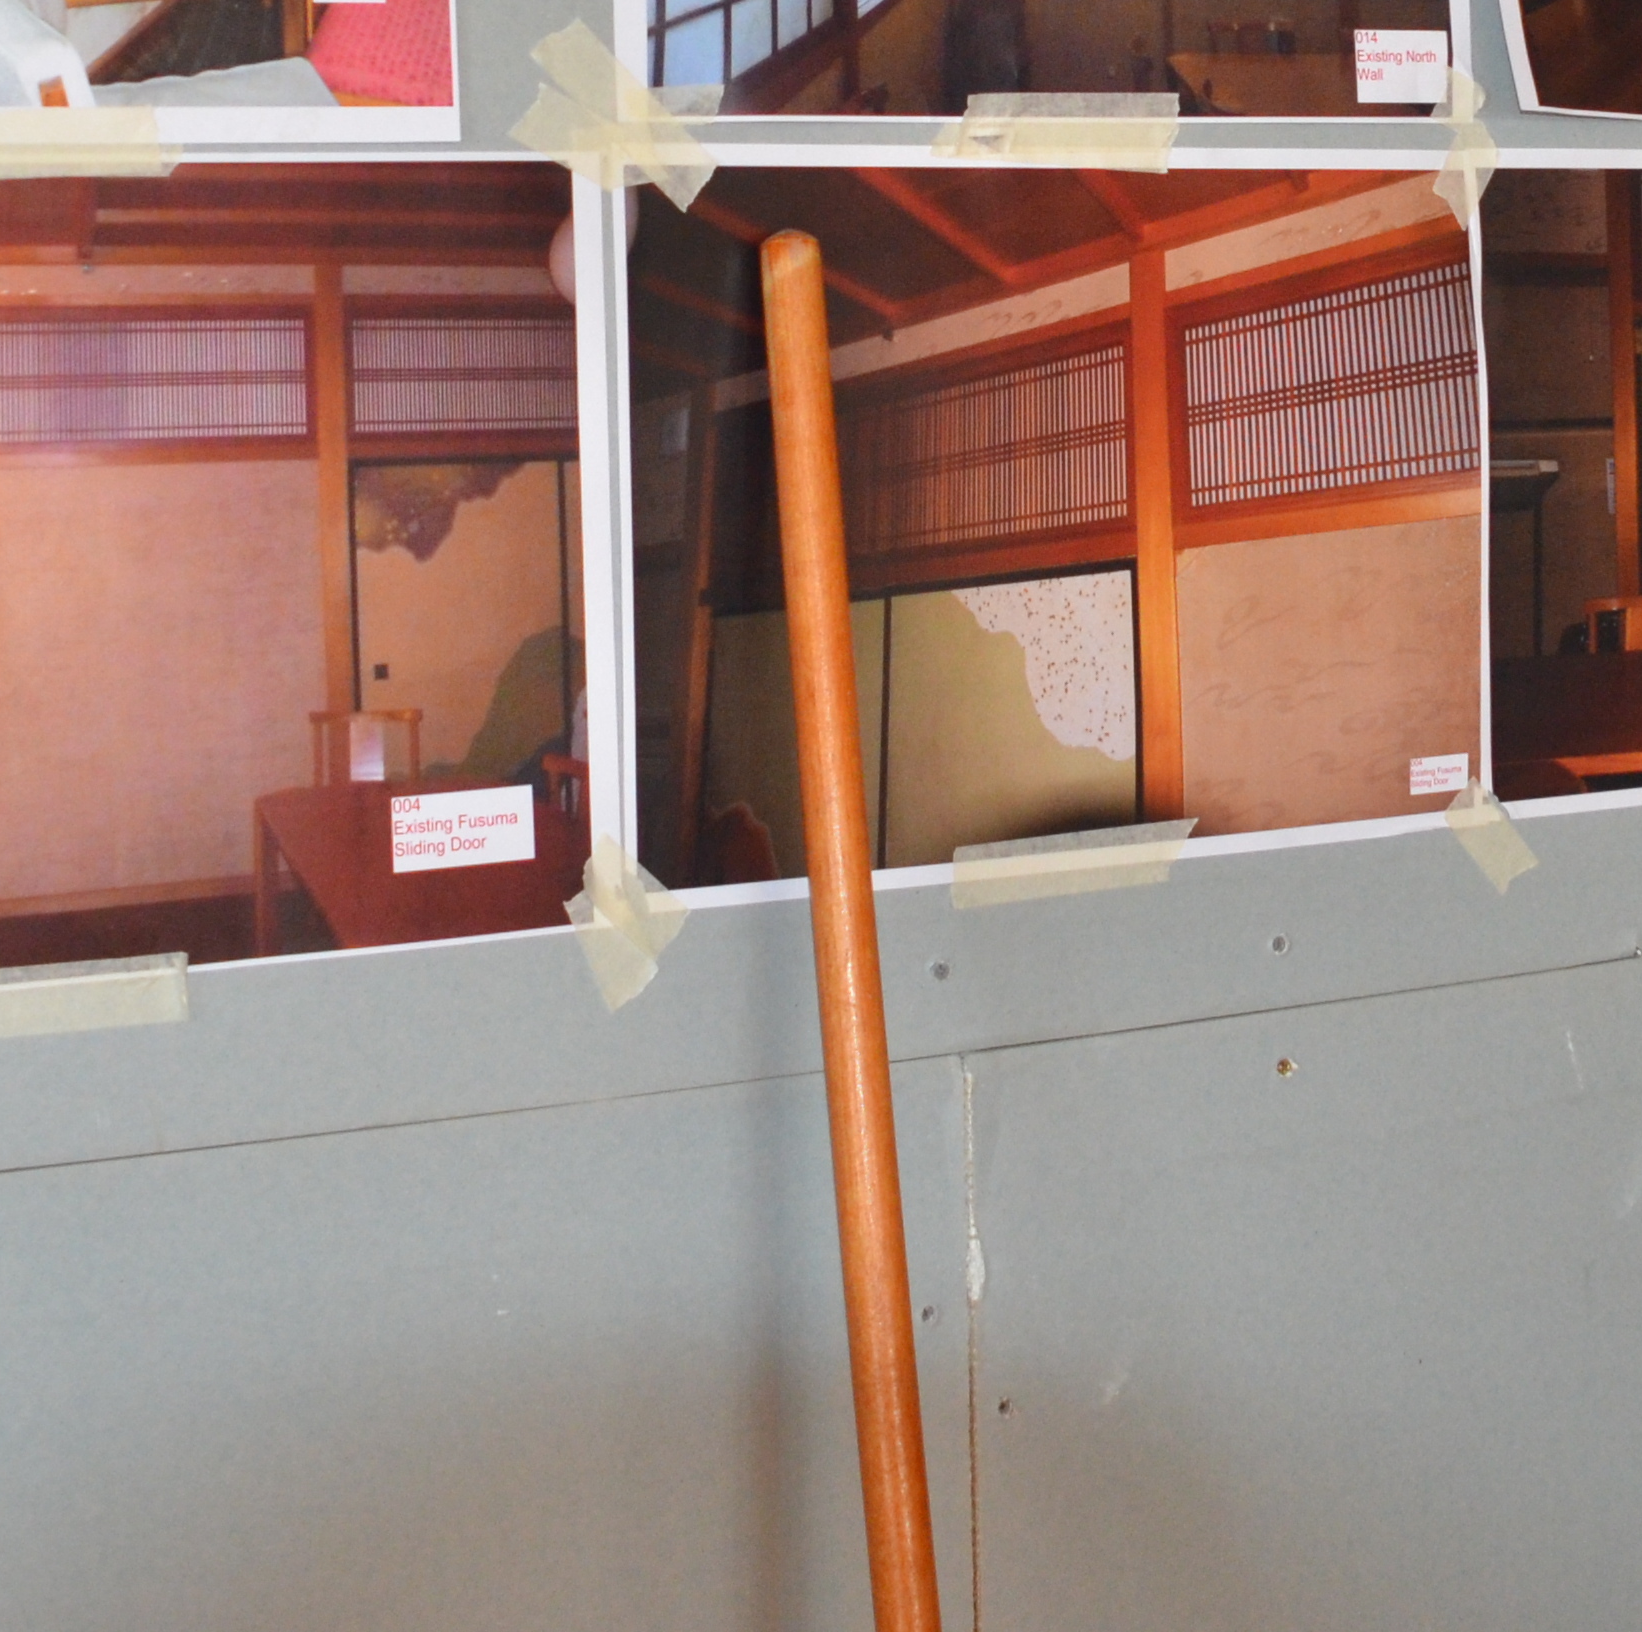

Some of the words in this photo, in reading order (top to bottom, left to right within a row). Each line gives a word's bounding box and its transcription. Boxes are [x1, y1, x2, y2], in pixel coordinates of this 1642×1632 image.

[1355, 32, 1378, 43] 014
[1357, 50, 1402, 65] Existing
[1406, 51, 1436, 62] North
[1357, 68, 1383, 80] Wall
[393, 798, 421, 813] 004
[394, 817, 453, 835] Existing
[458, 813, 518, 829] Fusuma
[395, 840, 445, 856] Sliding
[451, 836, 487, 852] Door
